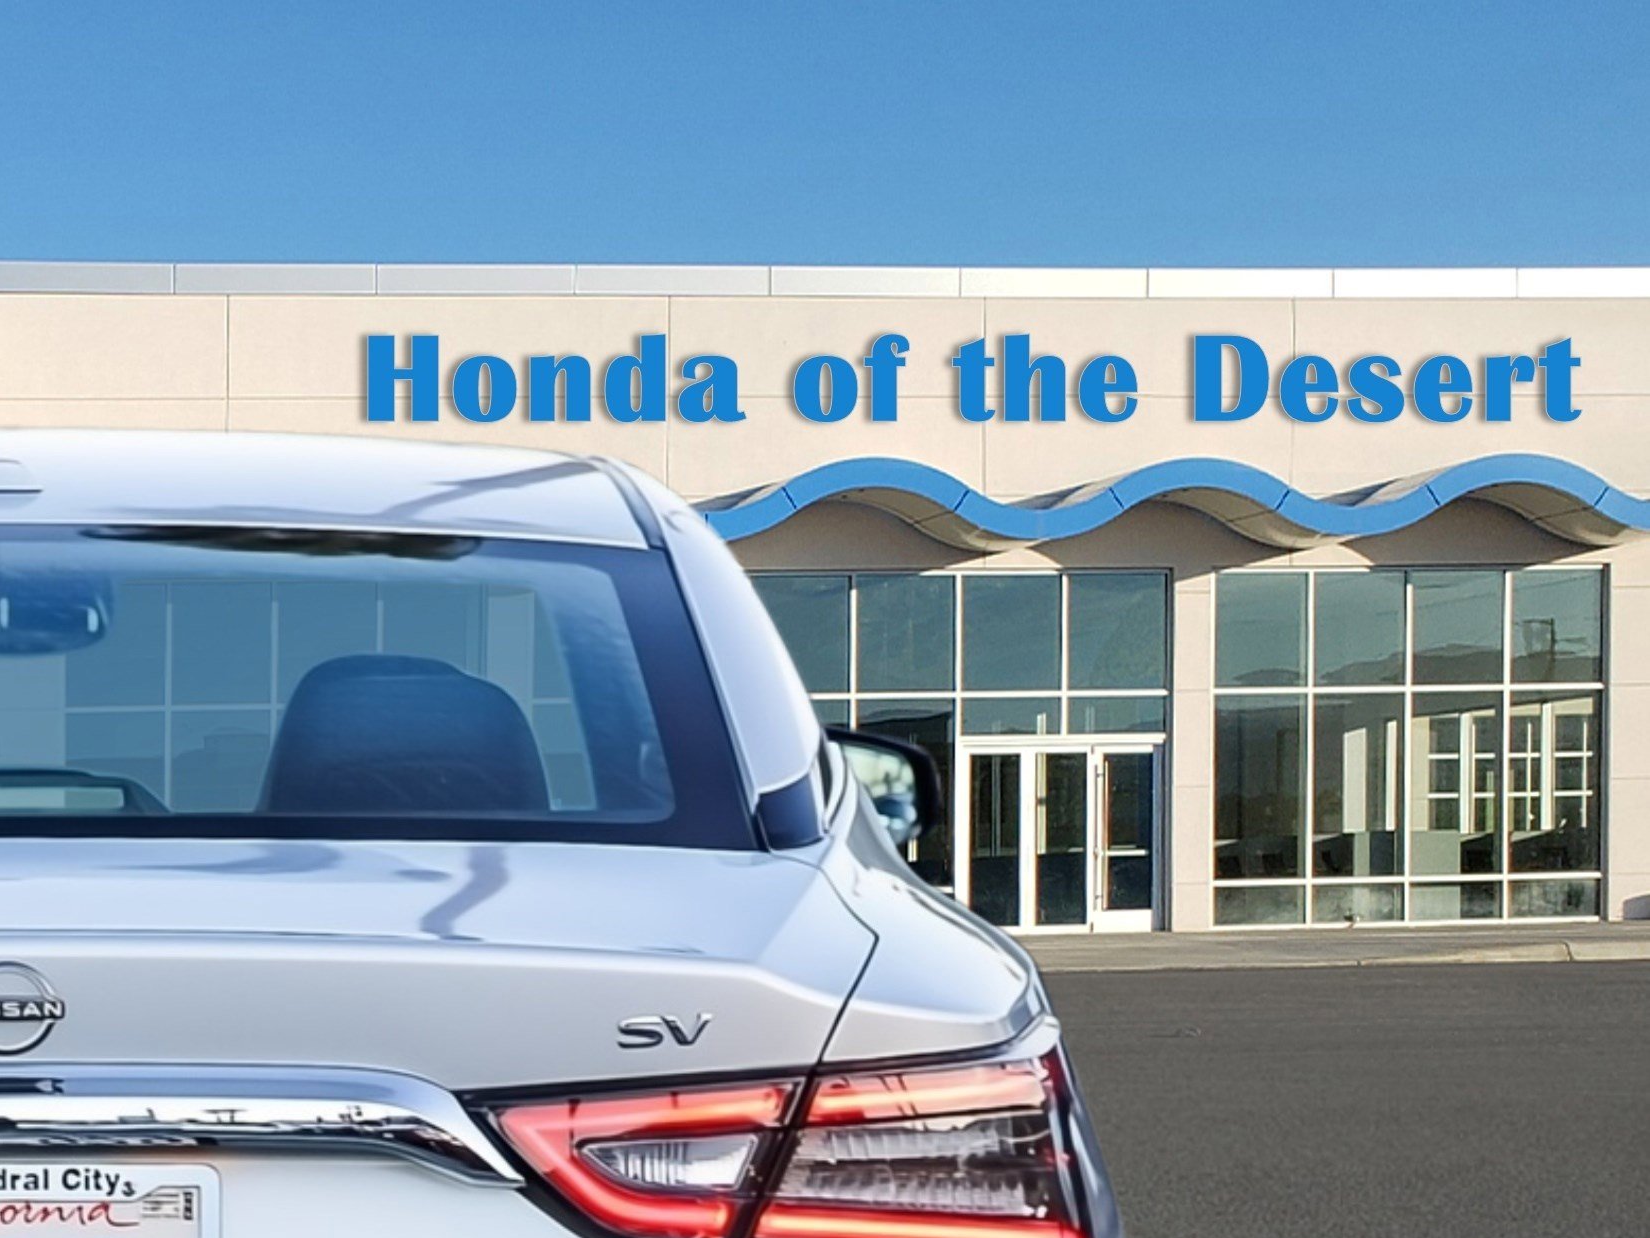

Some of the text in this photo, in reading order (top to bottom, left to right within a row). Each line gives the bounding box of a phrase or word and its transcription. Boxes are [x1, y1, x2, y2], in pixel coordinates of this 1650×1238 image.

[367, 333, 1583, 423] Honda of the Desert
[616, 1013, 713, 1049] SV
[61, 1167, 121, 1197] City
